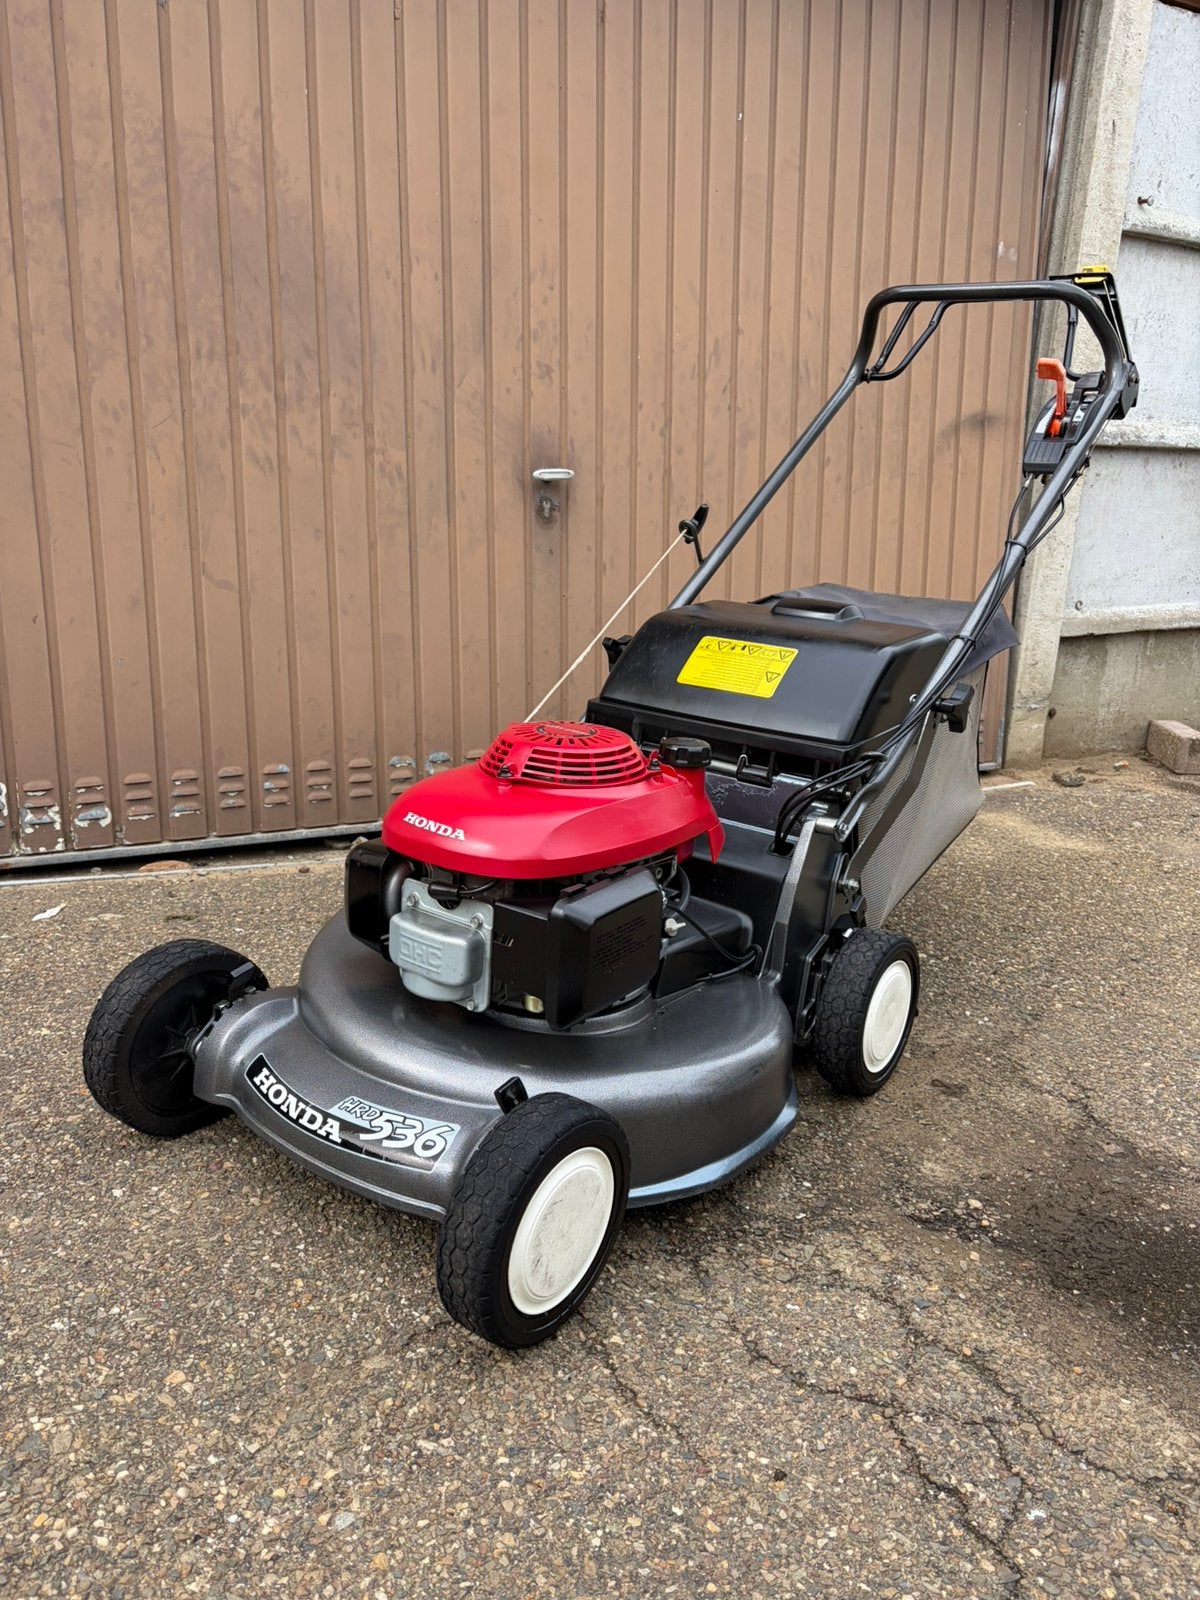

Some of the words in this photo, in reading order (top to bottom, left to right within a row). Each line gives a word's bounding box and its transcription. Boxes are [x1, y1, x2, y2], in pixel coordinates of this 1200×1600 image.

[403, 811, 466, 841] HONDA
[253, 1067, 342, 1144] HONDA
[338, 1097, 382, 1122] HRD
[359, 1110, 456, 1158] 536
